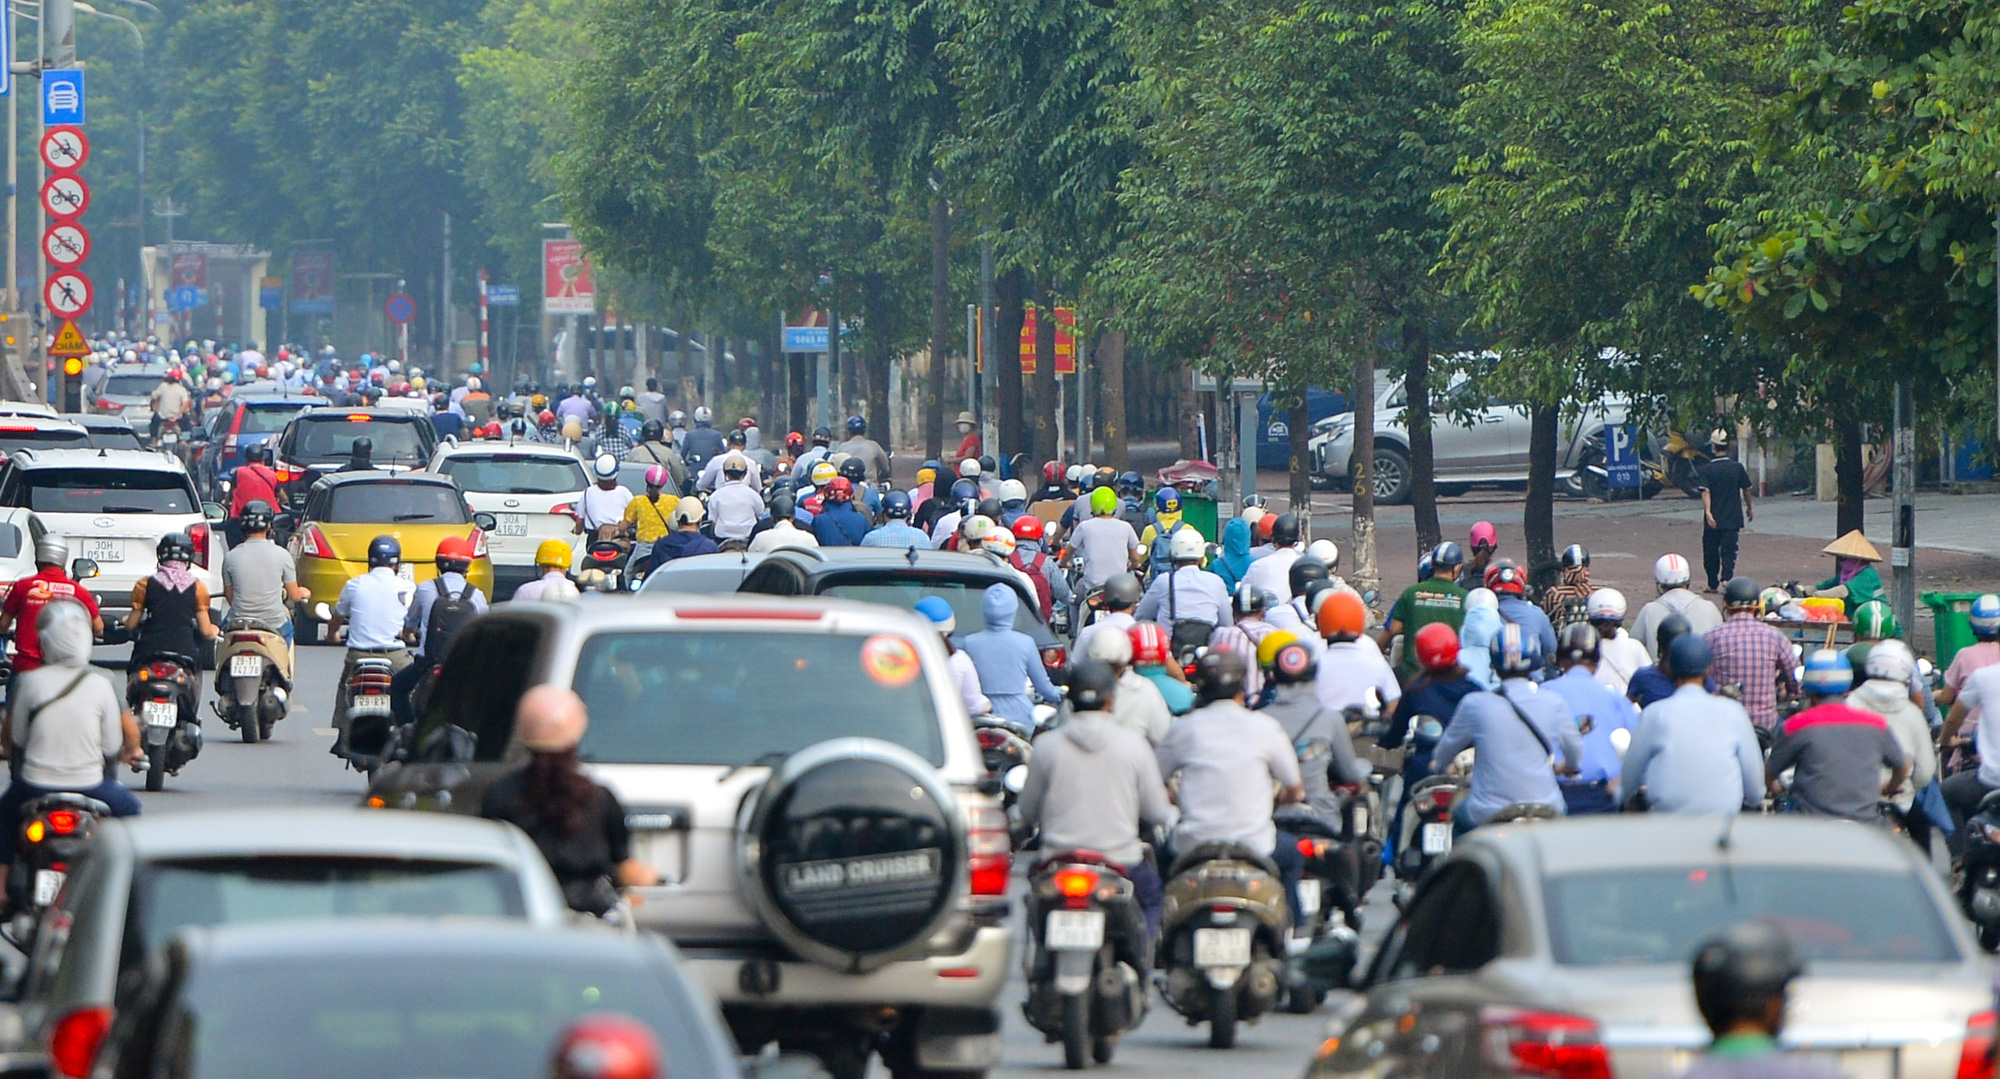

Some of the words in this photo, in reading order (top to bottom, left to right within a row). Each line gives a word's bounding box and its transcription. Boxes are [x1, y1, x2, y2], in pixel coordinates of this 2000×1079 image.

[1613, 426, 1628, 462] P
[503, 514, 520, 524] 30A
[95, 541, 112, 550] 30H
[87, 551, 120, 560] 051.64
[788, 862, 845, 890] LAND
[846, 854, 931, 884] CRUISER
